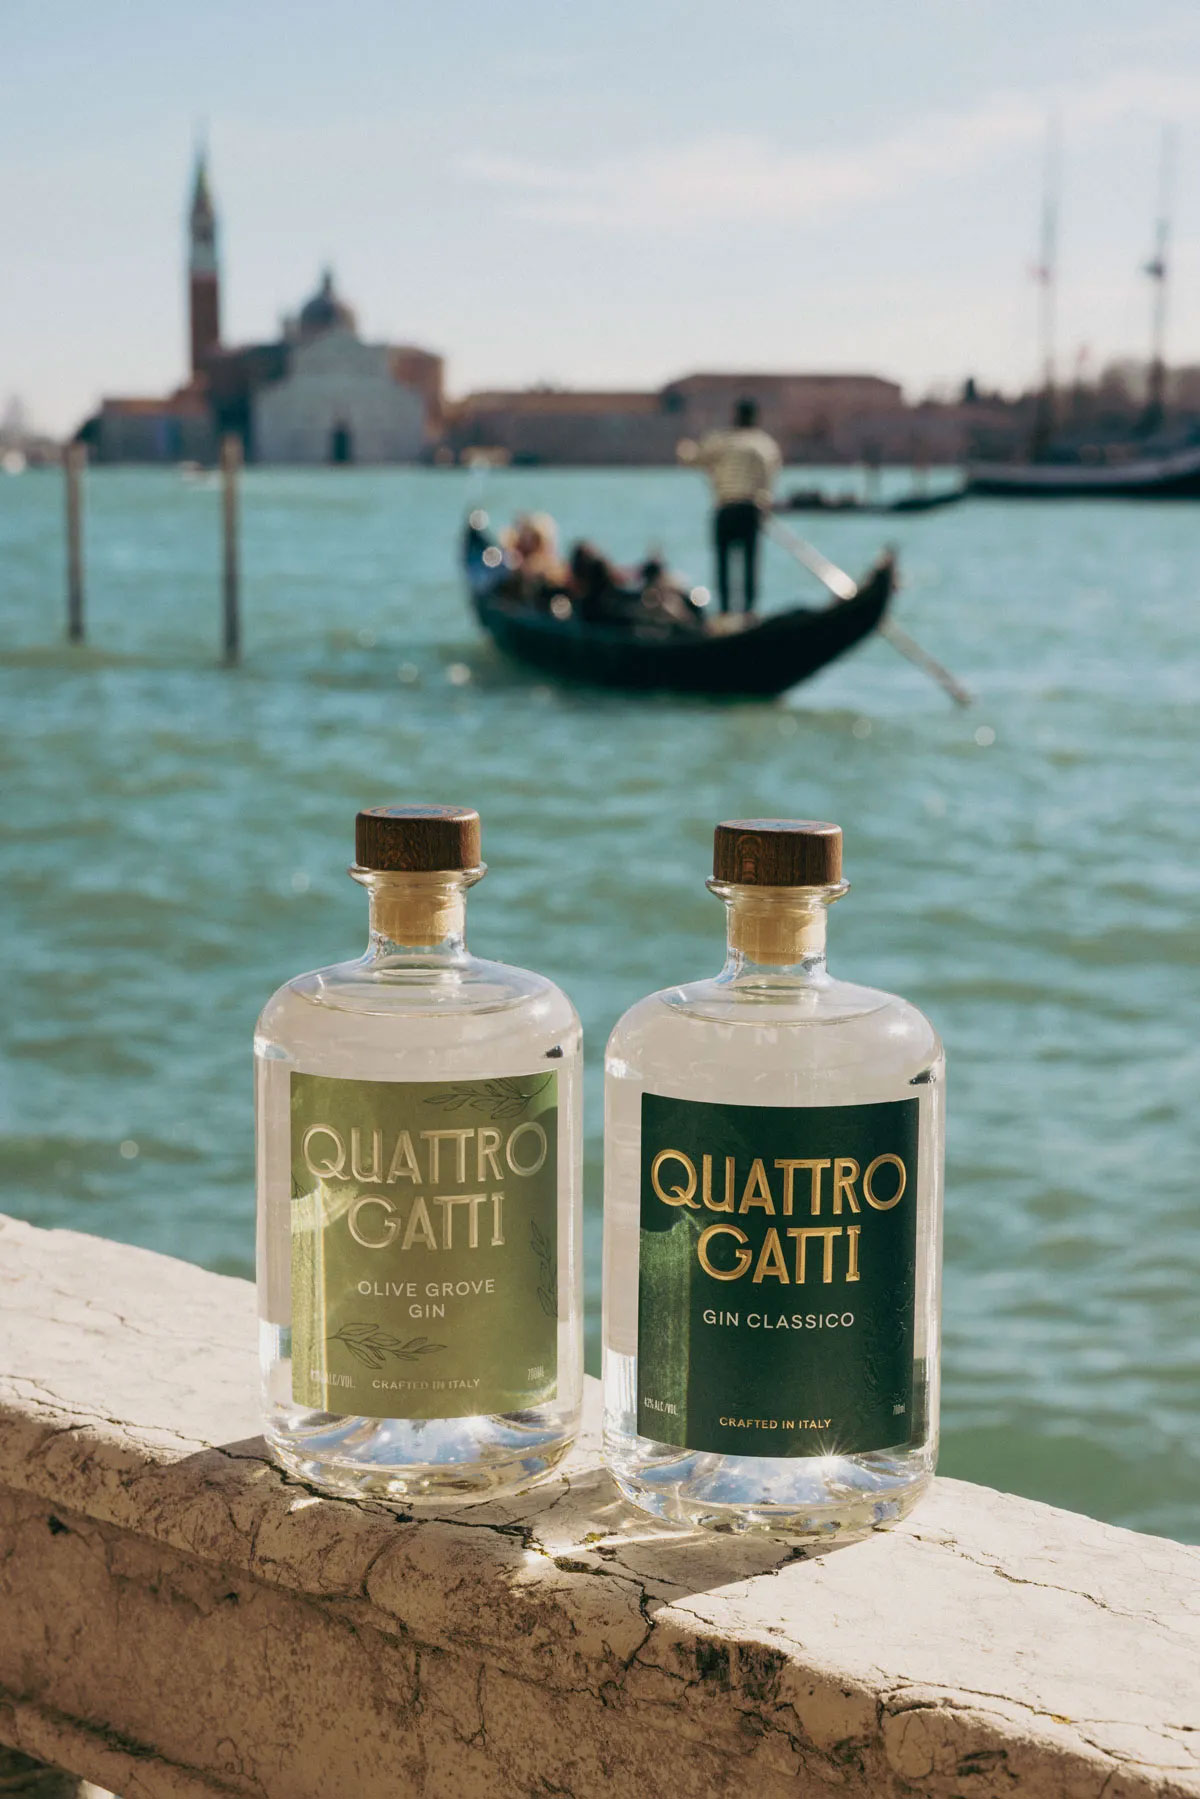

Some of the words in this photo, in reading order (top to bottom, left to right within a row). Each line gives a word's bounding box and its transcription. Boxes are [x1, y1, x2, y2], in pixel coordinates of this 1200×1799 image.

[301, 1121, 548, 1184] QUATTRO
[650, 1148, 907, 1216] QUATTRO
[347, 1191, 505, 1250] GATTI
[696, 1223, 862, 1284] GATTI
[357, 1280, 417, 1297] OLIVE
[425, 1279, 496, 1297] GROVE
[408, 1303, 446, 1318] GIN
[702, 1309, 739, 1327] GIN
[746, 1312, 855, 1329] CLASSICO
[371, 1379, 429, 1390] CRAFTED
[432, 1380, 445, 1390] IN
[448, 1378, 480, 1390] ITALY
[719, 1416, 778, 1429] CRAFTED
[782, 1420, 795, 1429] IN
[799, 1419, 832, 1429] ITALY
